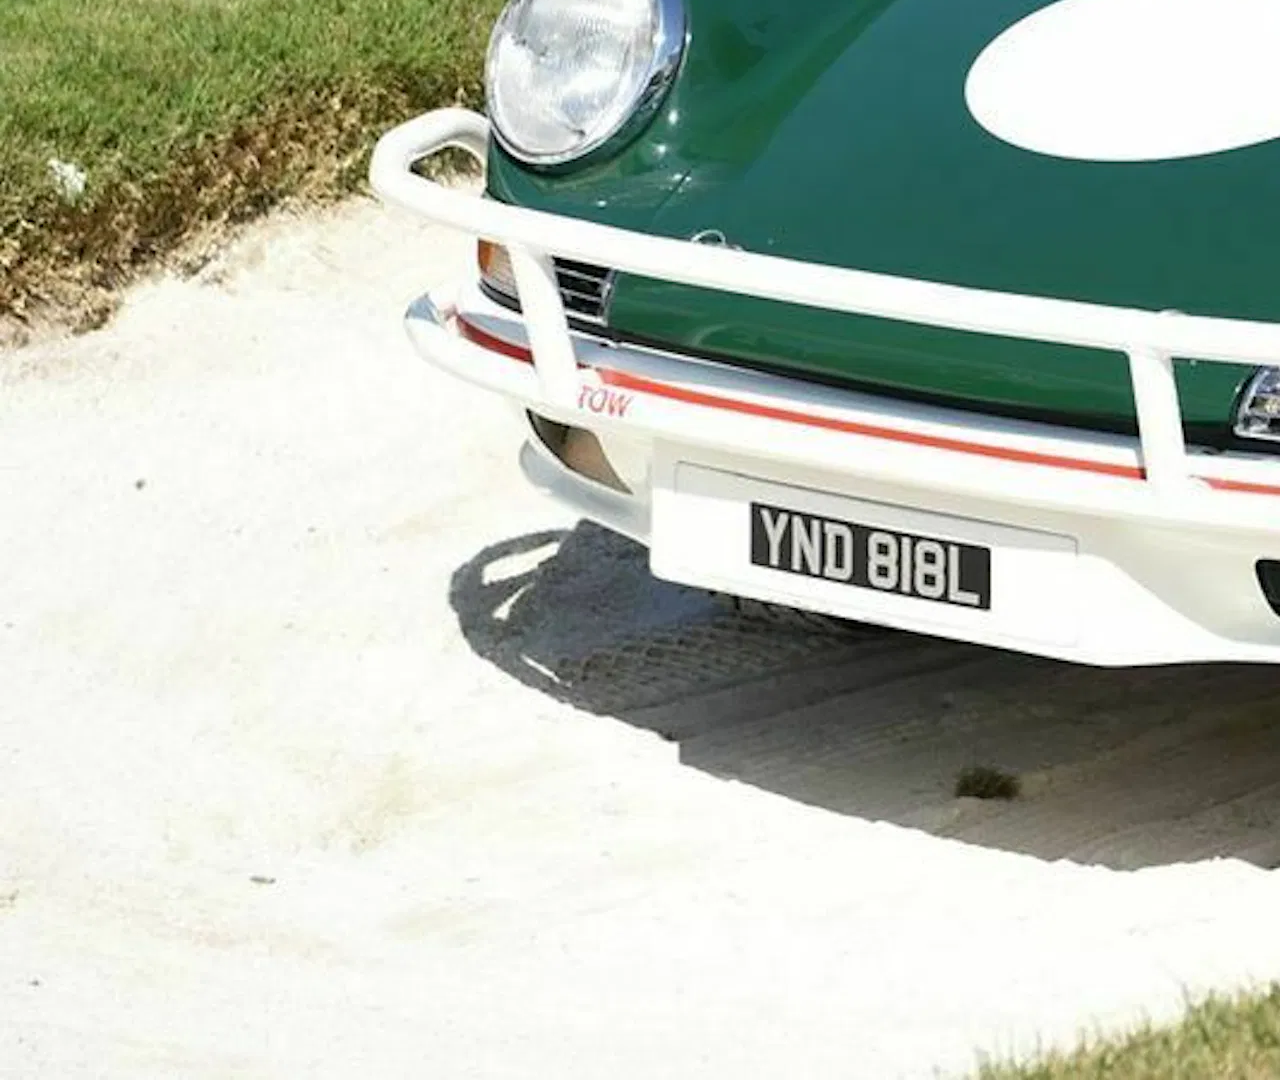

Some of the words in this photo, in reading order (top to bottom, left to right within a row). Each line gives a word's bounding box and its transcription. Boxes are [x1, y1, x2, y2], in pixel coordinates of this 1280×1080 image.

[577, 384, 635, 418] TOW
[760, 508, 853, 581] YND
[867, 531, 980, 606] 818L
